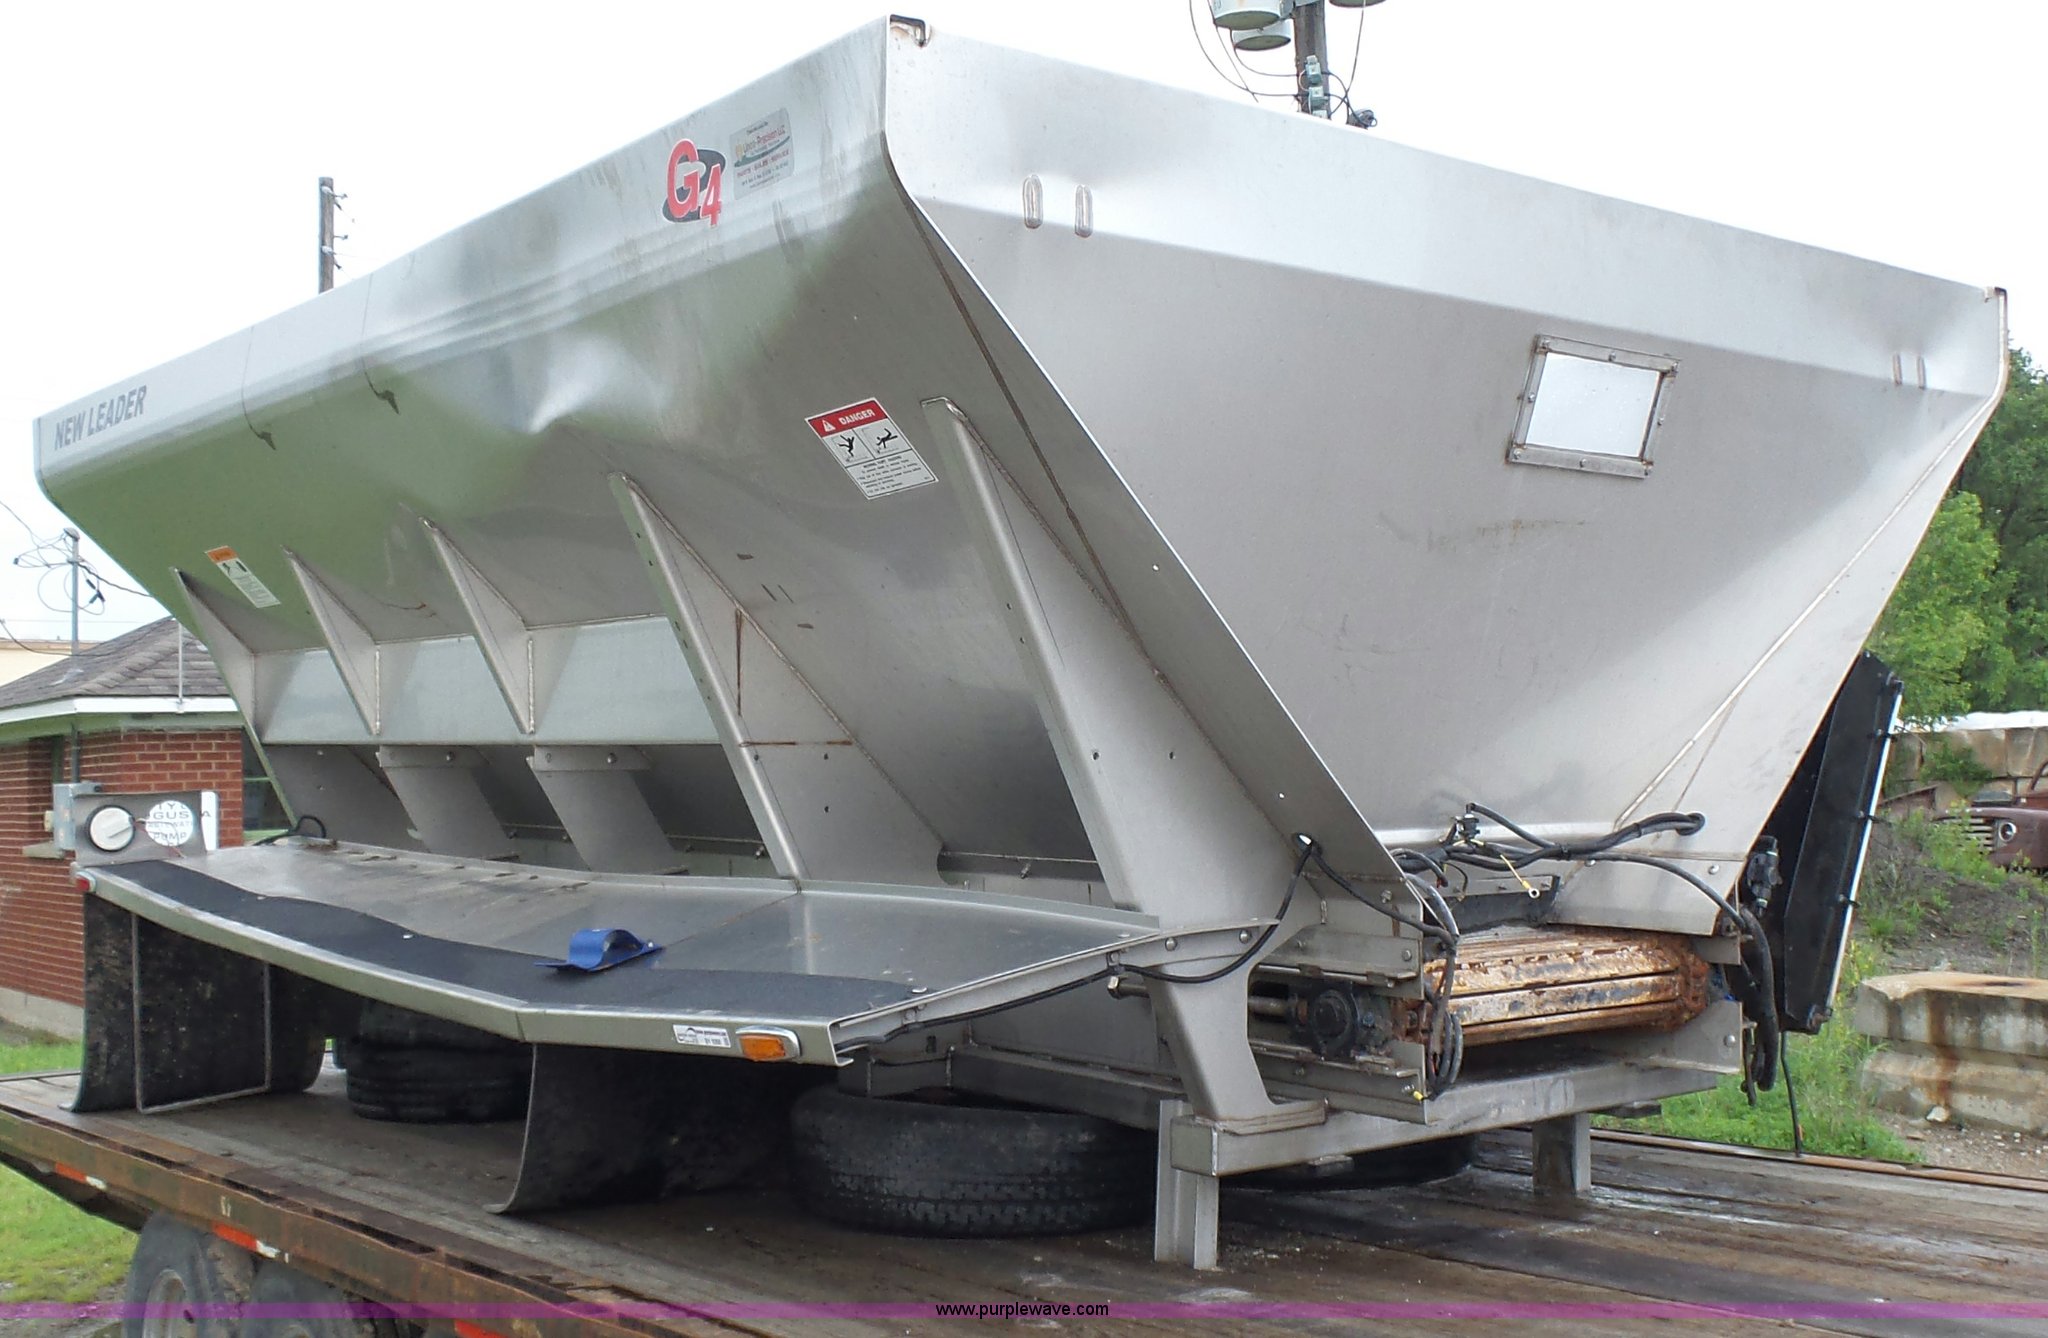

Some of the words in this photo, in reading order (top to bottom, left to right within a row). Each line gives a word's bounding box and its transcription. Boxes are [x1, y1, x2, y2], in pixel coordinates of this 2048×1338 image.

[667, 139, 721, 227] G4
[55, 411, 86, 450] NEW
[88, 385, 147, 436] LEADER
[838, 409, 876, 425] DANGER
